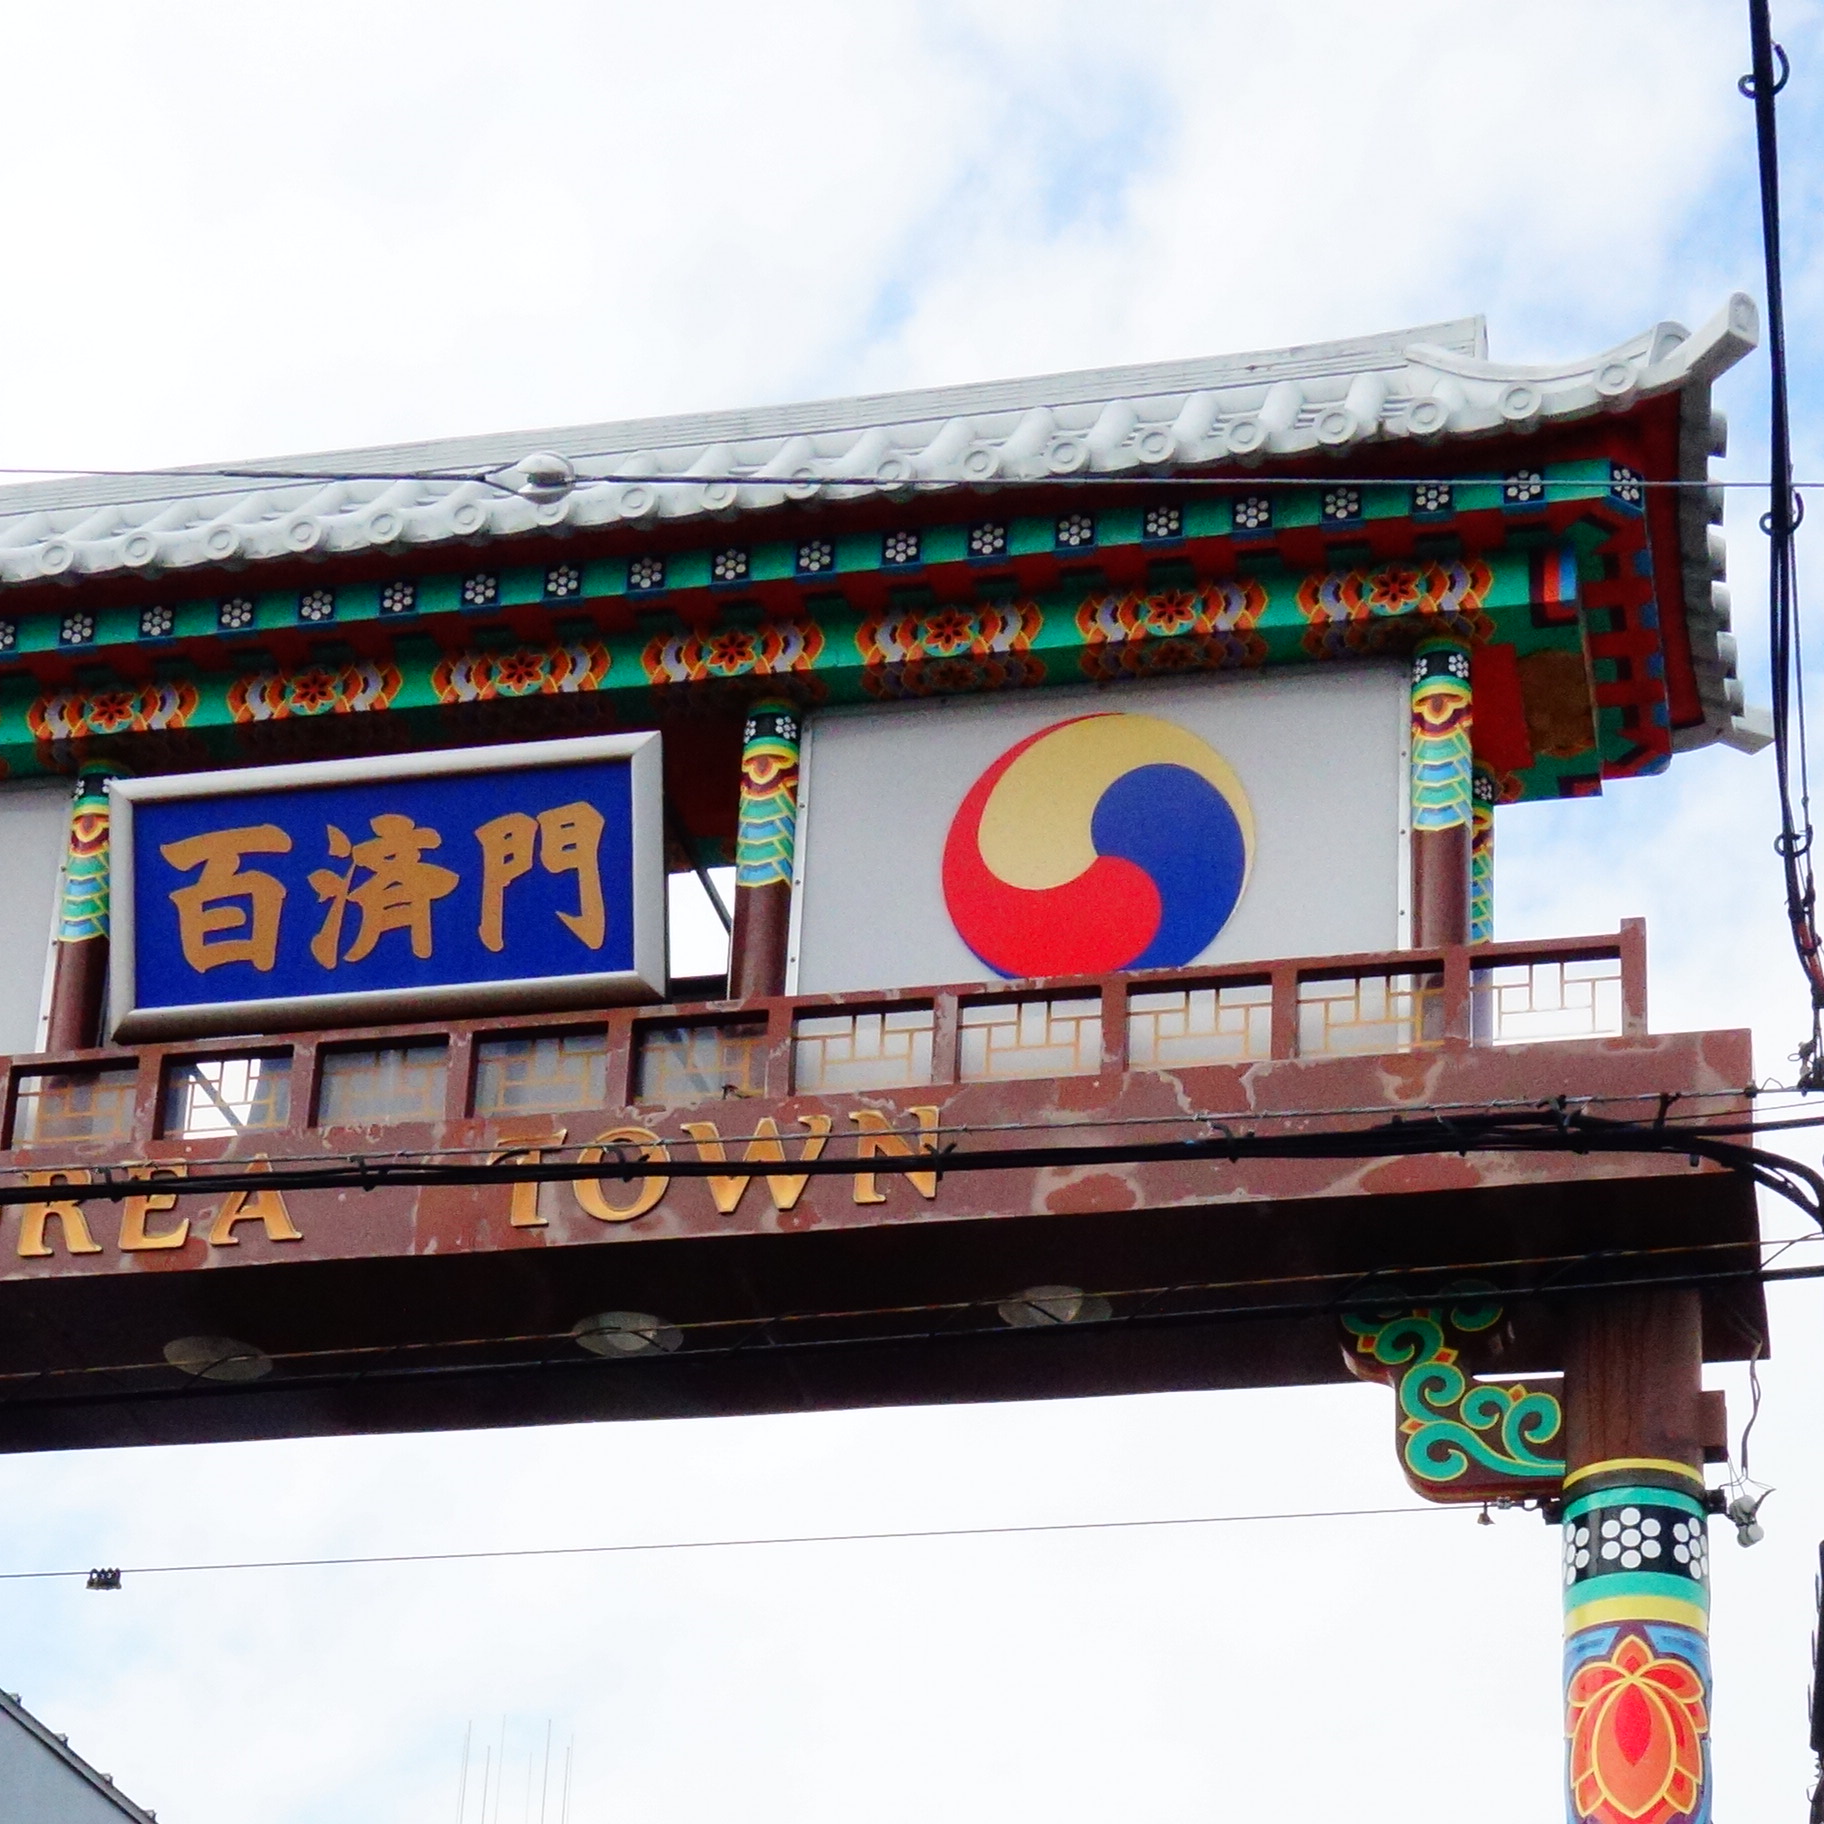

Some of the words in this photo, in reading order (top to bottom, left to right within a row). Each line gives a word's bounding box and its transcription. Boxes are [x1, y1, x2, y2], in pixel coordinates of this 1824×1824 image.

[159, 800, 606, 975] 百済門
[486, 1105, 940, 1228] TOWN
